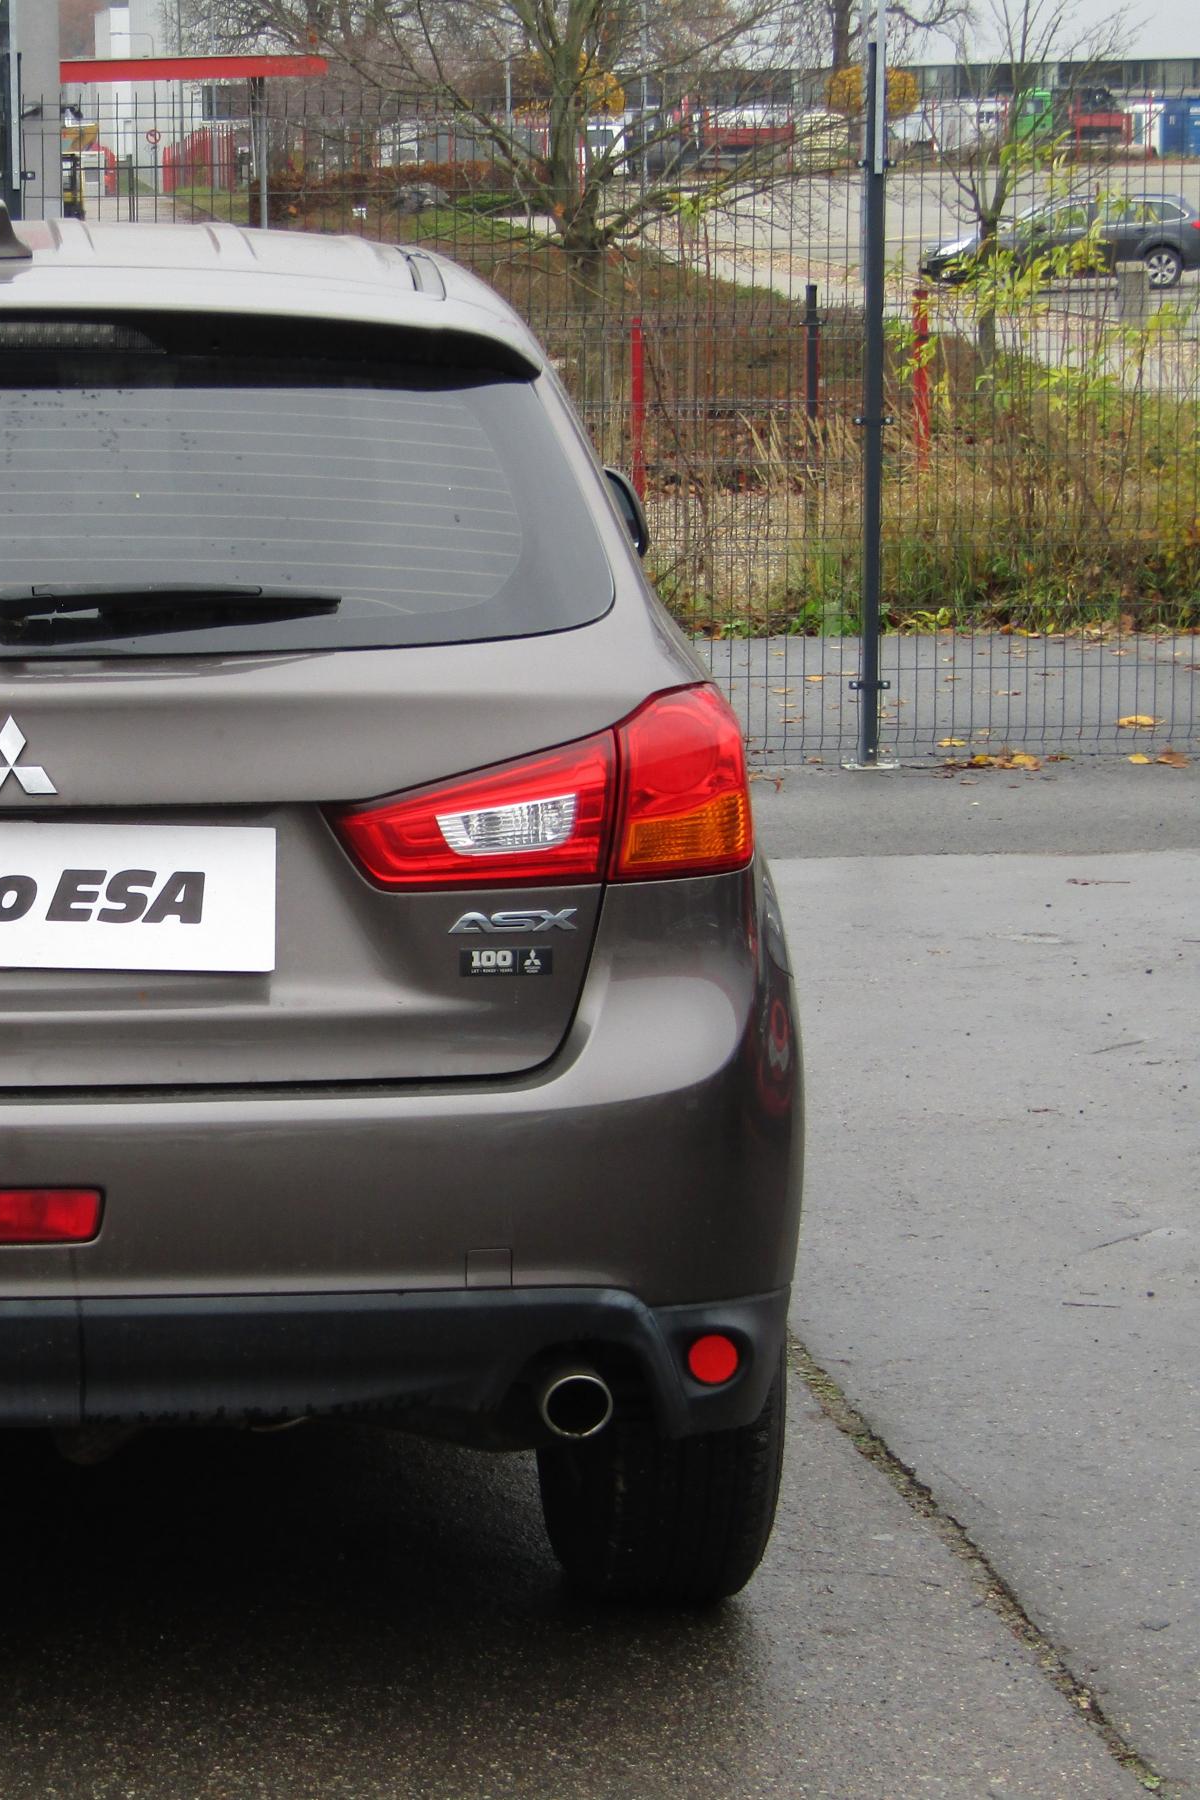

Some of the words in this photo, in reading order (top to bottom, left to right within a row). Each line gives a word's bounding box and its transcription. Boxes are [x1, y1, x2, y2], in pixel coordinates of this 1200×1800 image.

[44, 868, 206, 925] ESA
[447, 908, 578, 934] ASX
[471, 950, 513, 968] 100
